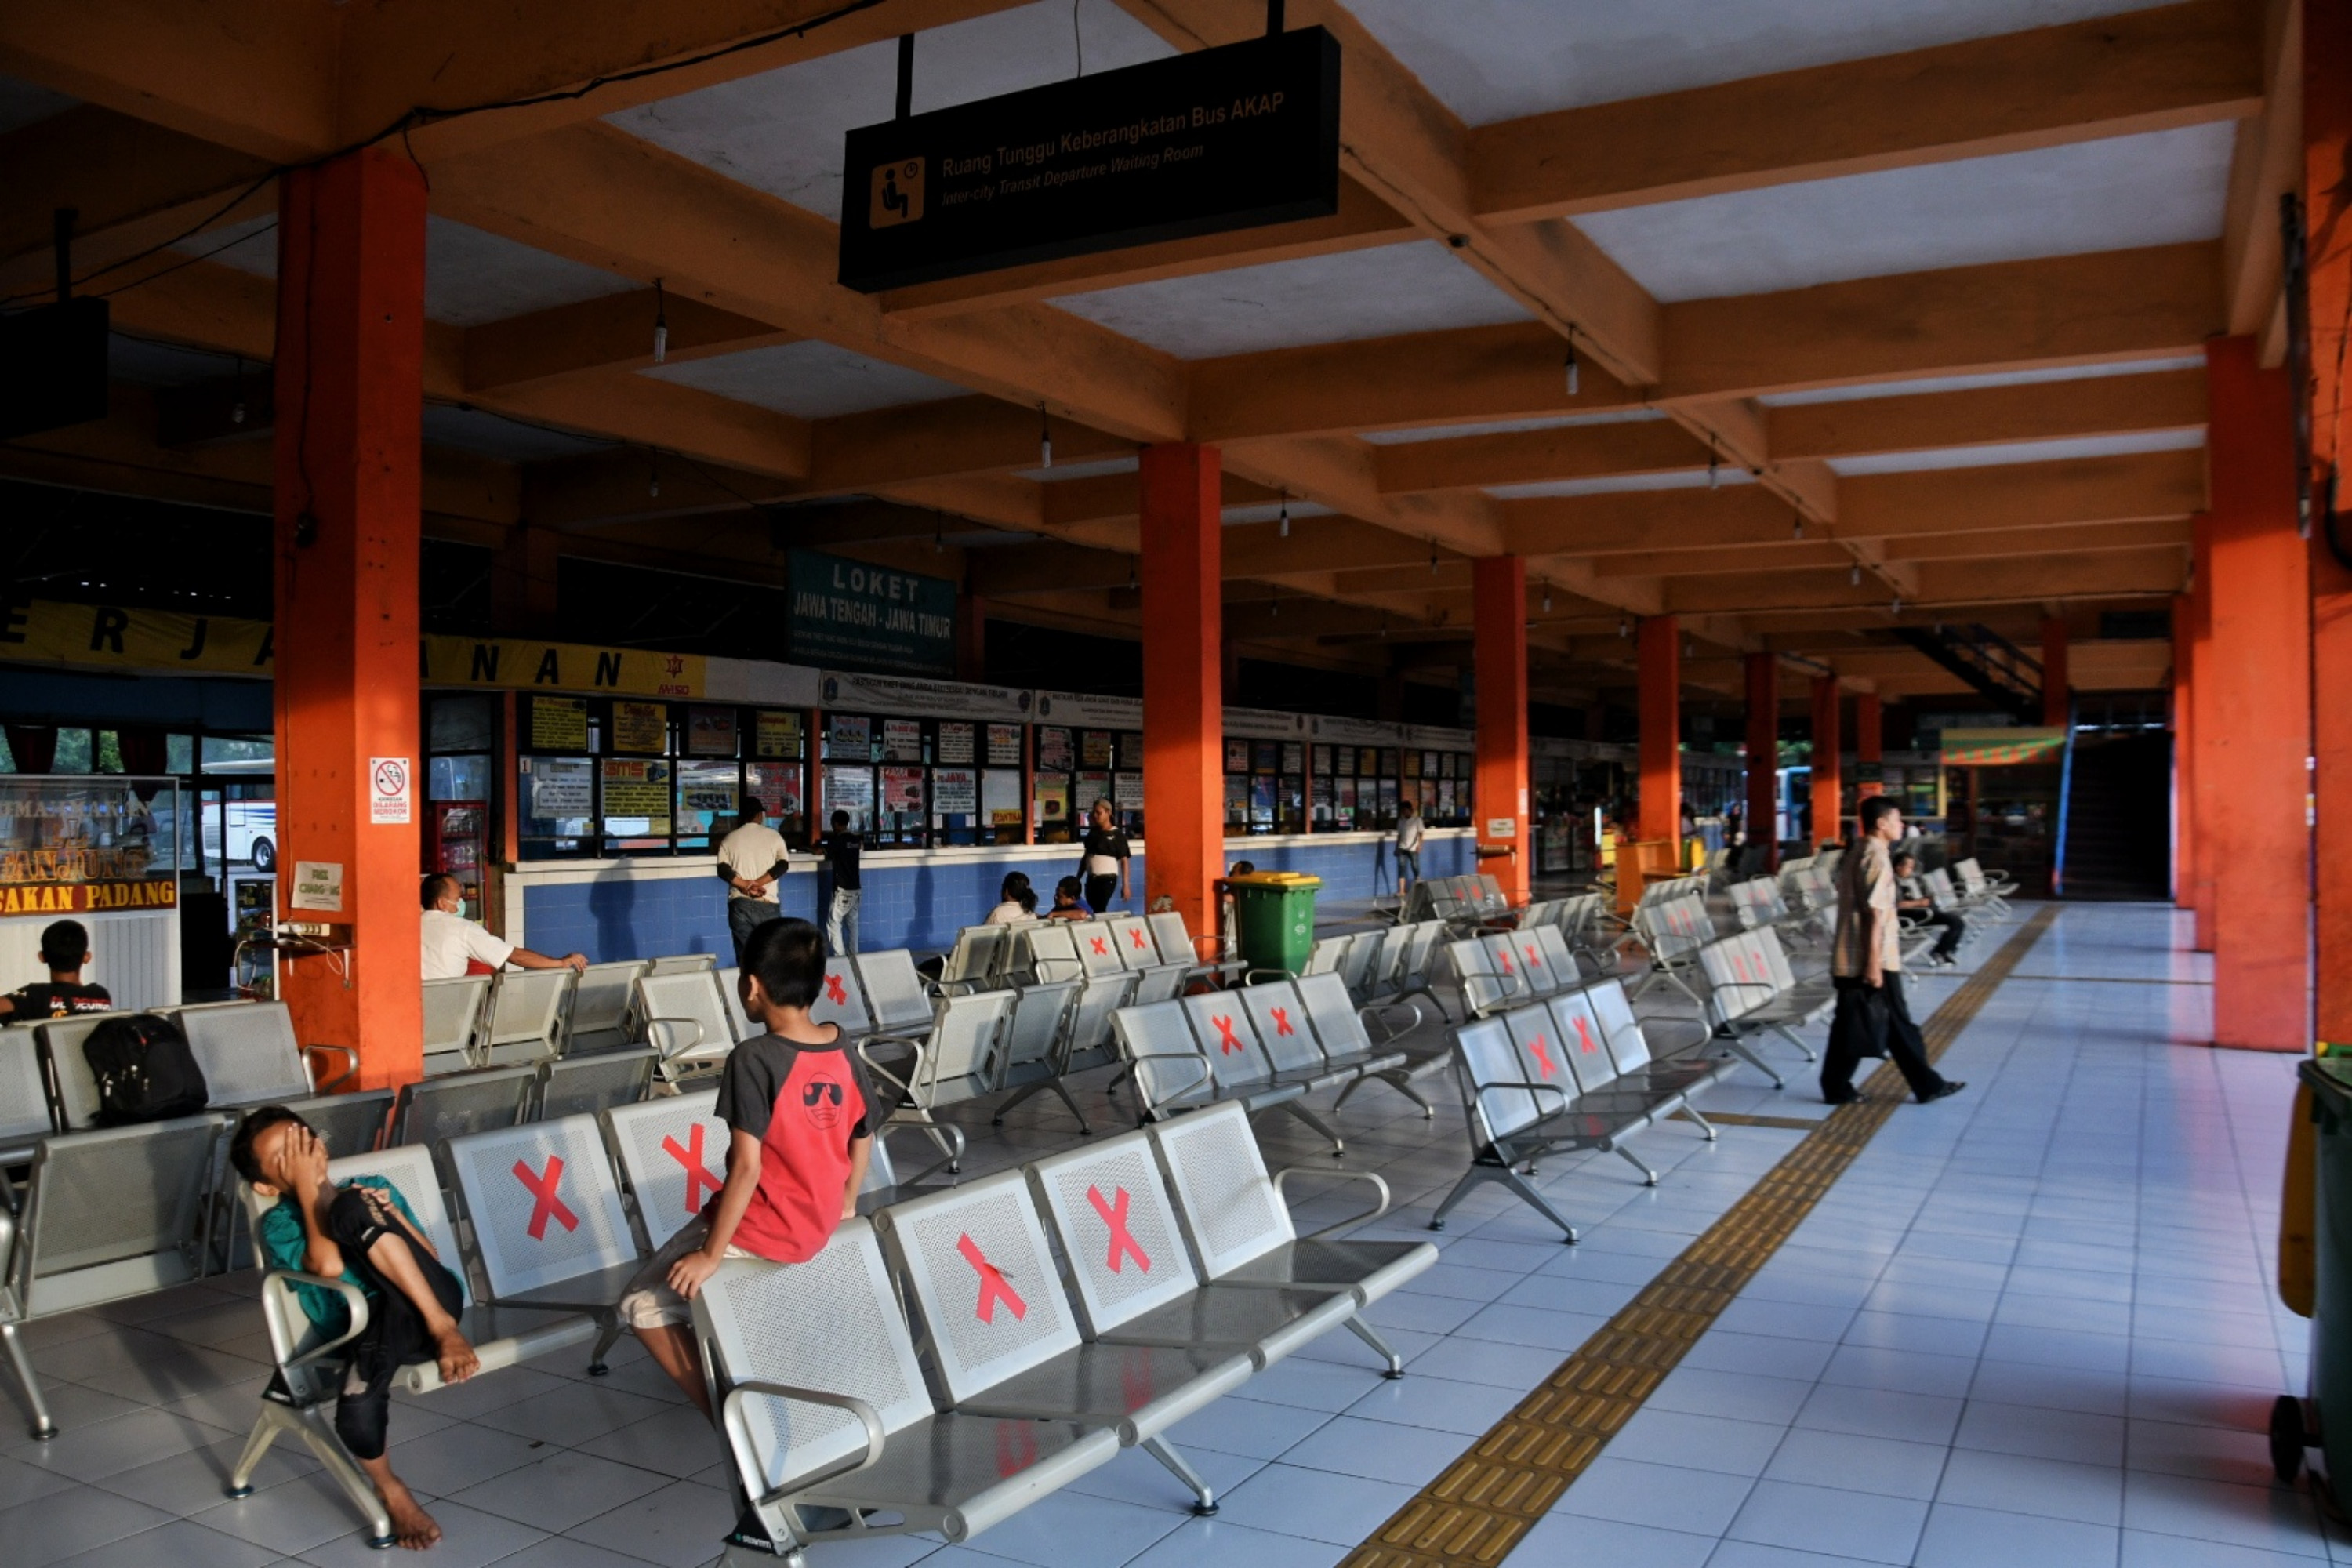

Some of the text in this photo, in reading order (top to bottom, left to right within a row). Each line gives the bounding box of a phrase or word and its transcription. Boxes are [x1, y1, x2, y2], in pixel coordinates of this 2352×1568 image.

[942, 91, 1285, 177] Ruang Tunggu Keberangkatan Bus AKAP
[942, 144, 1204, 206] Inter-city Transit Departure Waiting Room
[833, 564, 919, 602] LOKET
[793, 592, 827, 619] JAWA
[829, 597, 877, 627] TENGAH
[885, 608, 916, 633] JAWA
[918, 613, 951, 640] TIMUR
[604, 761, 644, 776] GMS
[85, 881, 175, 909] PADANG
